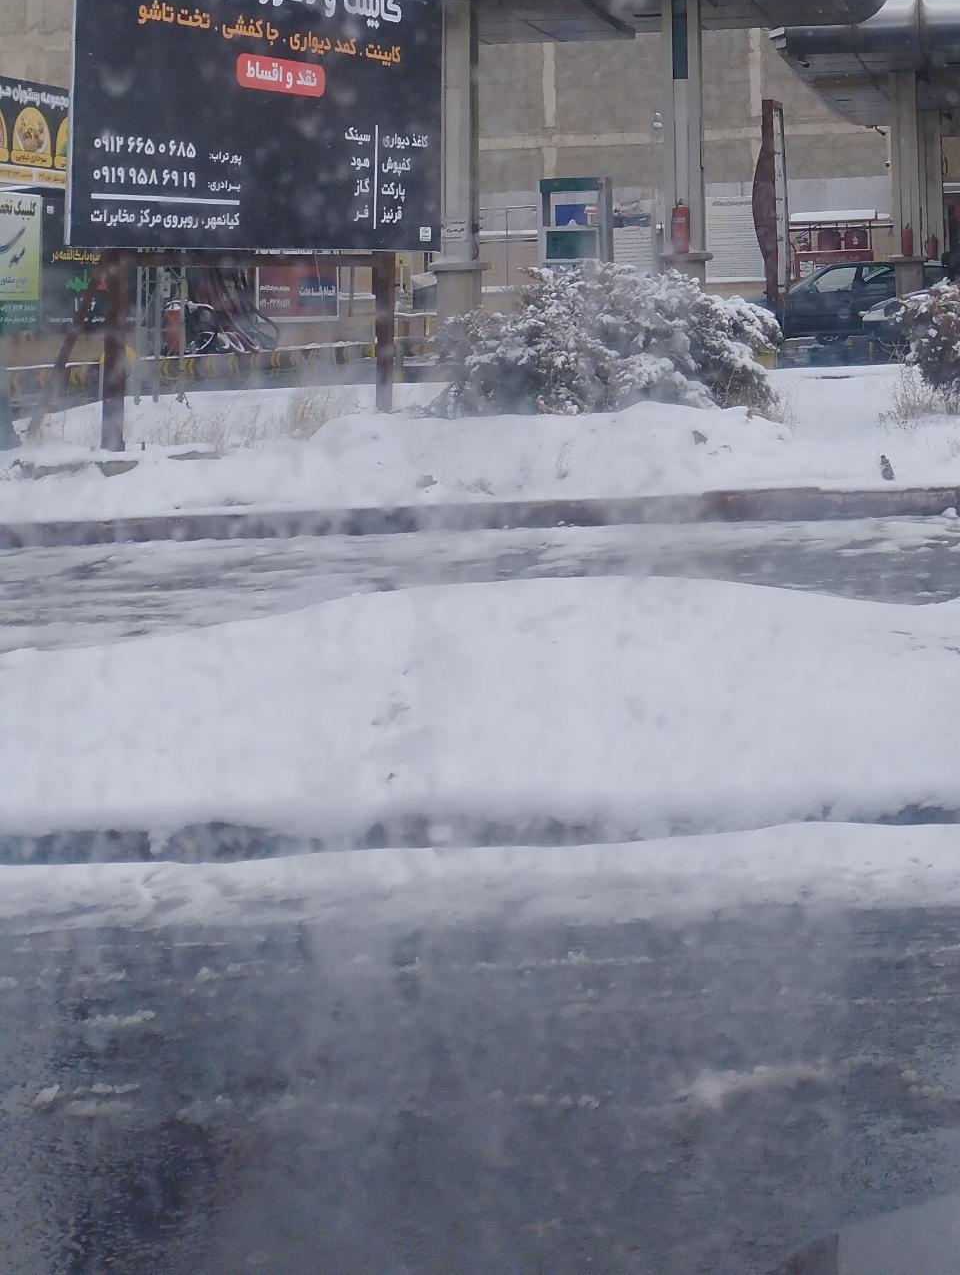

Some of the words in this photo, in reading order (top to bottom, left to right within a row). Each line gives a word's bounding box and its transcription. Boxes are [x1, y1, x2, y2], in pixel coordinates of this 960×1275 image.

[137, 0, 174, 25] تاشو
[176, 9, 211, 29] تخت
[222, 15, 263, 39] کفشی
[289, 31, 331, 55] دیواری
[334, 37, 357, 56] کمد
[365, 42, 401, 67] کابینت
[246, 61, 283, 83] اقساط
[285, 71, 293, 90] و
[296, 69, 318, 88] نقد
[94, 136, 124, 153] ۰۹۱۲
[128, 136, 155, 155] ۶۶۵
[344, 127, 371, 146] سینک
[382, 133, 410, 149] دیواری
[412, 134, 429, 148] کاغذ
[350, 155, 370, 171] هود
[381, 155, 411, 176] کفپوش
[93, 166, 125, 184] ۰۹۱۹
[129, 168, 158, 185] ۹۵۸
[353, 178, 370, 197] گاز
[381, 182, 406, 203] پارکت
[91, 209, 135, 227] مخابرات
[137, 209, 162, 227] مرکز
[163, 214, 199, 229] روبروی
[353, 205, 369, 222] فر
[380, 206, 403, 223] قرنیز
